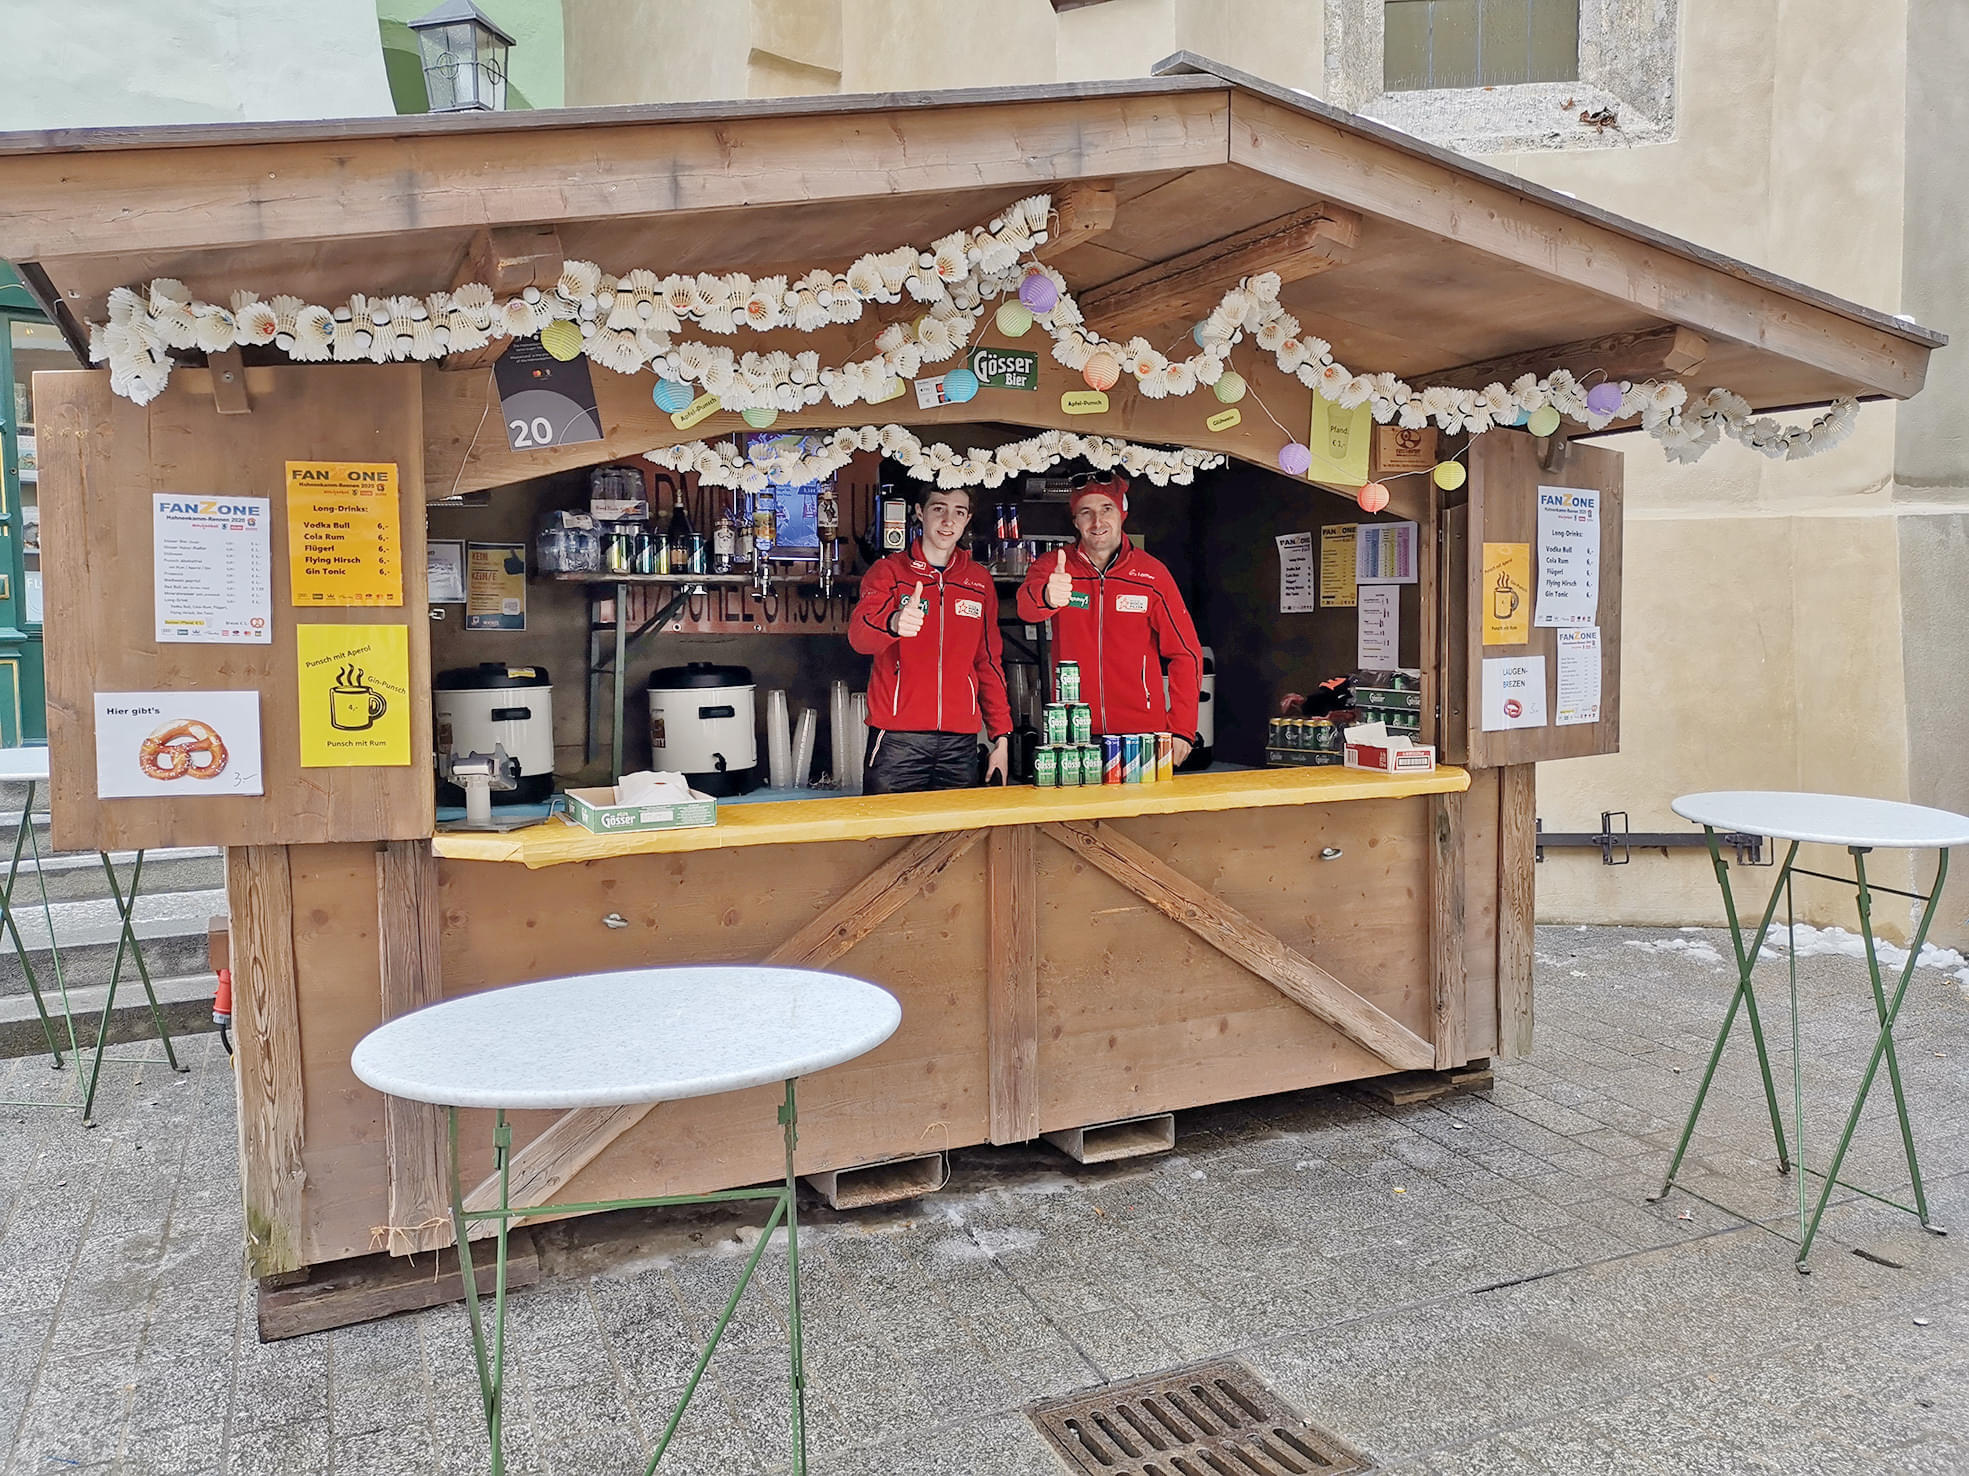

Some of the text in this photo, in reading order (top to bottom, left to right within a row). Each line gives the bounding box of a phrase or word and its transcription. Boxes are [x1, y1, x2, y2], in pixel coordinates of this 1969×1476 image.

[973, 350, 1034, 383] Gösser
[1005, 373, 1028, 387] Bier
[509, 417, 553, 447] 20
[1541, 493, 1595, 508] FANZONE
[160, 501, 260, 516] FANZONE
[313, 505, 369, 513] Long-Drinks:
[378, 534, 389, 542] 6,-
[305, 545, 335, 553] Flügerl
[305, 557, 331, 565] Flying
[28, 578, 41, 589] FL
[1560, 631, 1597, 641] FANZONE
[305, 645, 372, 668] Punsch mit Aperol
[367, 675, 407, 695] Gin-Punsch
[131, 707, 161, 716] gibt's
[601, 812, 636, 828] Gösser
